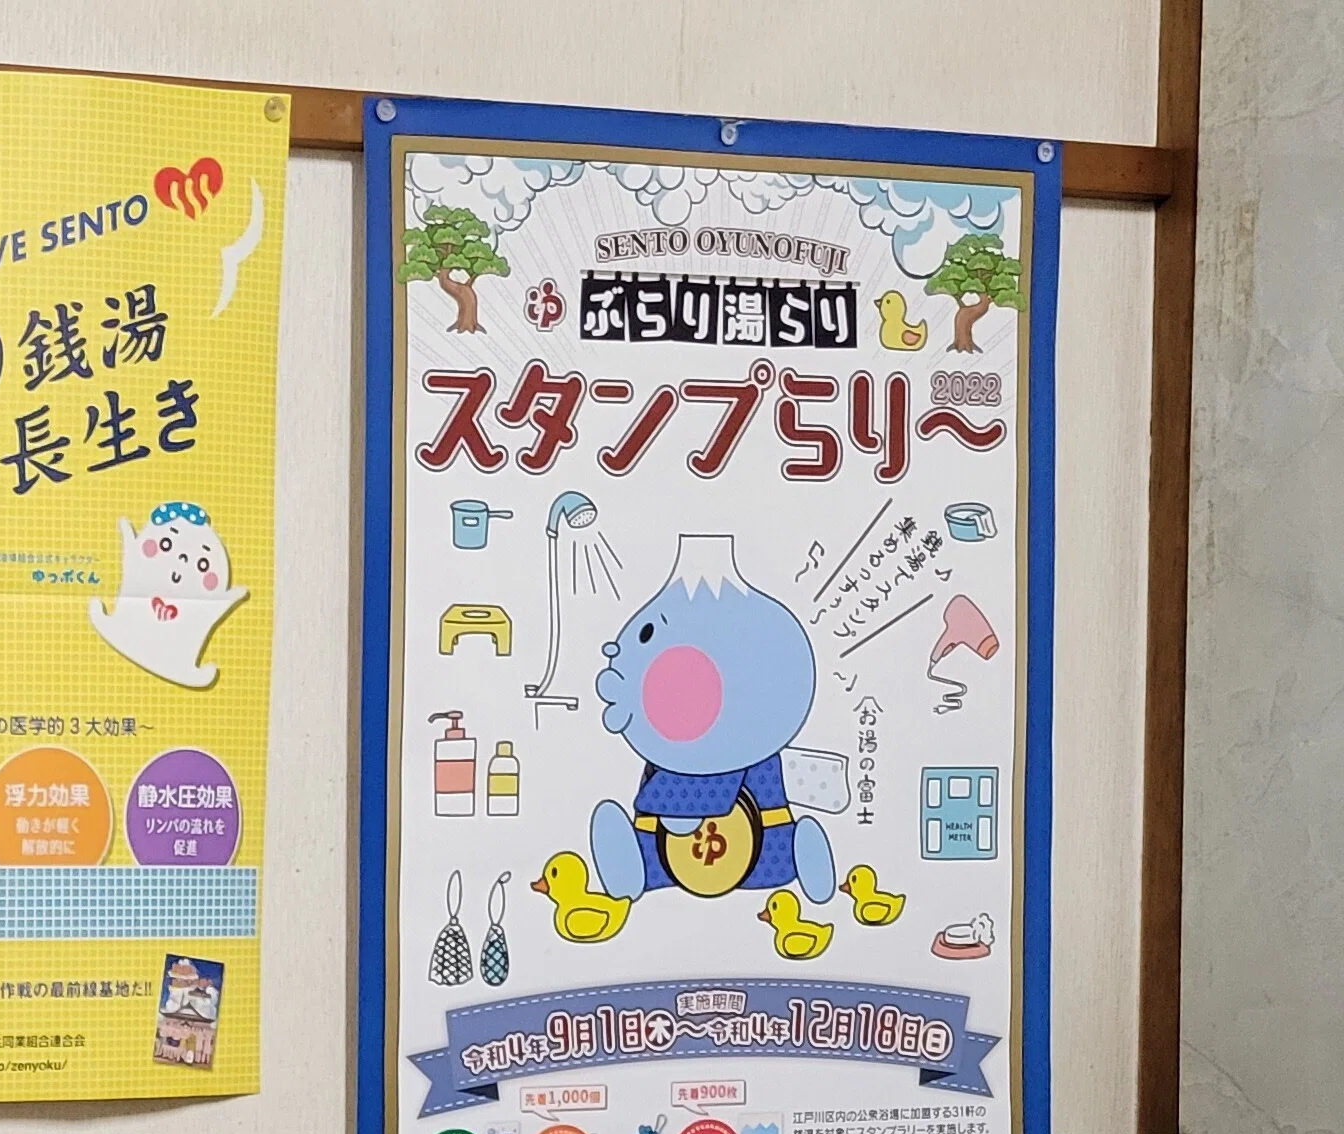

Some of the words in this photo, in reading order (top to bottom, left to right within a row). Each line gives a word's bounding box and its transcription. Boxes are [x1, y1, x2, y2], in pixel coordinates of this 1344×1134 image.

[39, 193, 150, 256] SENTO
[597, 230, 689, 262] SENTO
[696, 228, 850, 275] OYUNOFUJI
[582, 284, 848, 345] ぶらり湯らり
[929, 370, 1003, 406] 2022
[853, 695, 884, 826] お湯の富士
[3, 782, 92, 809] 浮力効果
[137, 783, 234, 810] 静水圧効果
[15, 816, 81, 835] 動きが軽く
[144, 817, 226, 836] リンパの流れを
[944, 821, 974, 831] HEALTH
[947, 832, 973, 843] METER
[172, 838, 199, 858] 促進
[677, 990, 747, 1012] 実施期間
